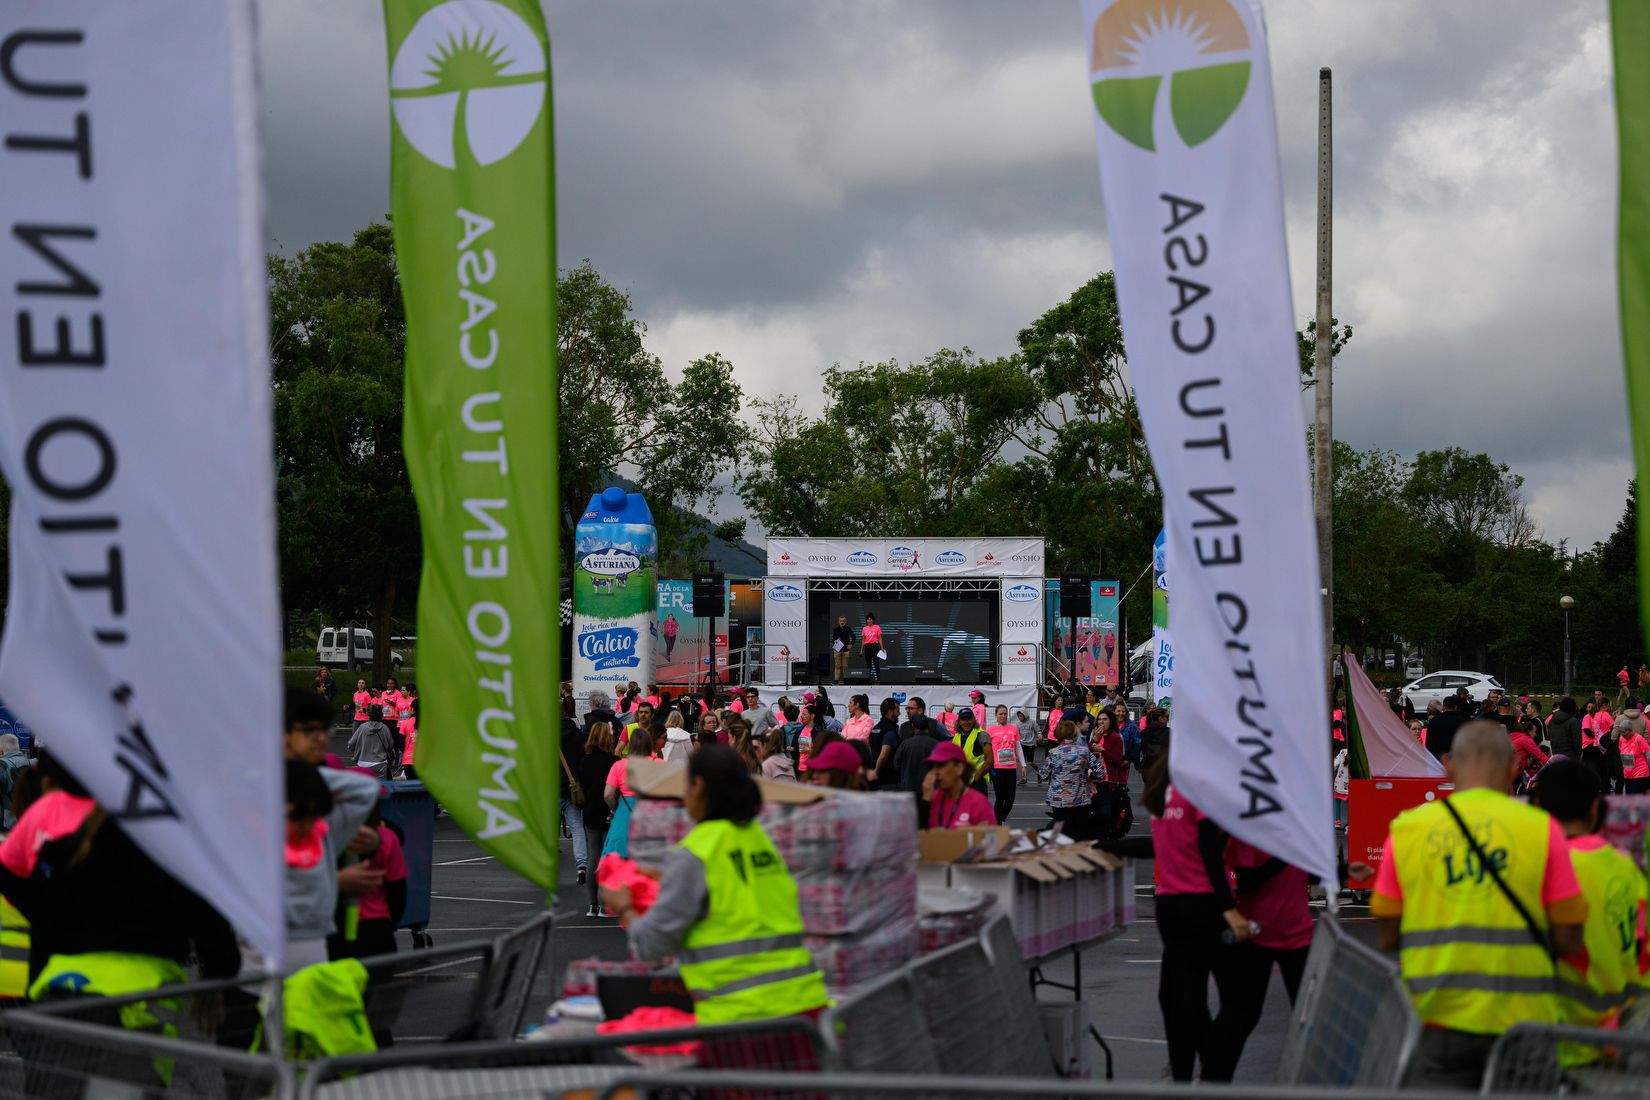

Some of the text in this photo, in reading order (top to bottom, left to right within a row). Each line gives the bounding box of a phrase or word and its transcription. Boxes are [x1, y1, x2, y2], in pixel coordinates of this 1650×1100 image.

[585, 558, 636, 569] ASTURIANA
[937, 555, 965, 563] ASTURIANA
[769, 620, 802, 628] OYSHO
[1007, 620, 1039, 628] OYSHO
[583, 633, 632, 657] Calcio
[603, 656, 630, 667] natural
